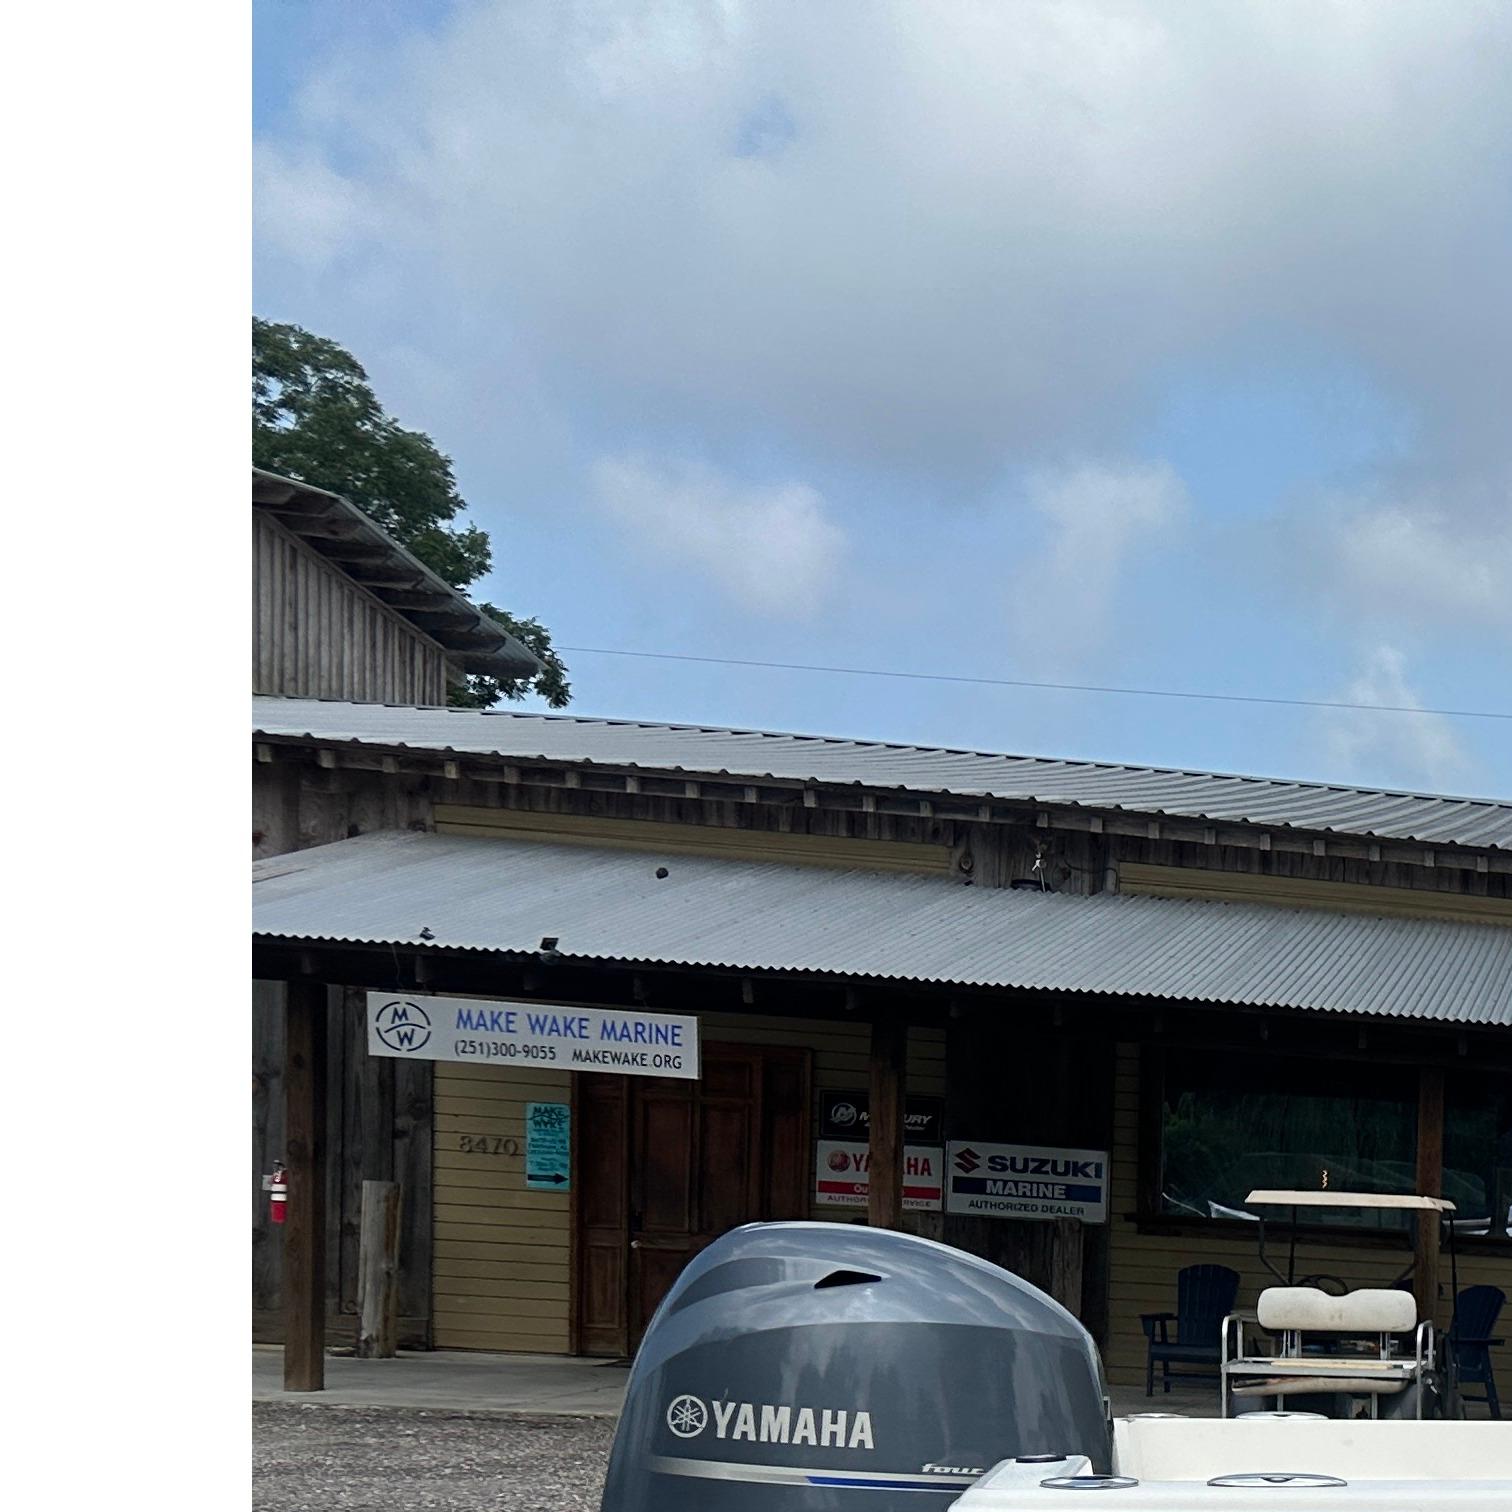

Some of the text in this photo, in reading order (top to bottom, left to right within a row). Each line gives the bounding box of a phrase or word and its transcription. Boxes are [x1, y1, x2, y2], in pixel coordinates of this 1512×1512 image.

[455, 1008, 684, 1047] MAKE WAKE MARINE
[454, 1040, 683, 1070] (251)300-9055 MAKEWAKE.ORG
[986, 1154, 1104, 1180] SUZUKI
[985, 1180, 1067, 1200] MARINE
[968, 1199, 1085, 1216] AUTHORIZED DEALER
[712, 1400, 874, 1449] YAMAHA
